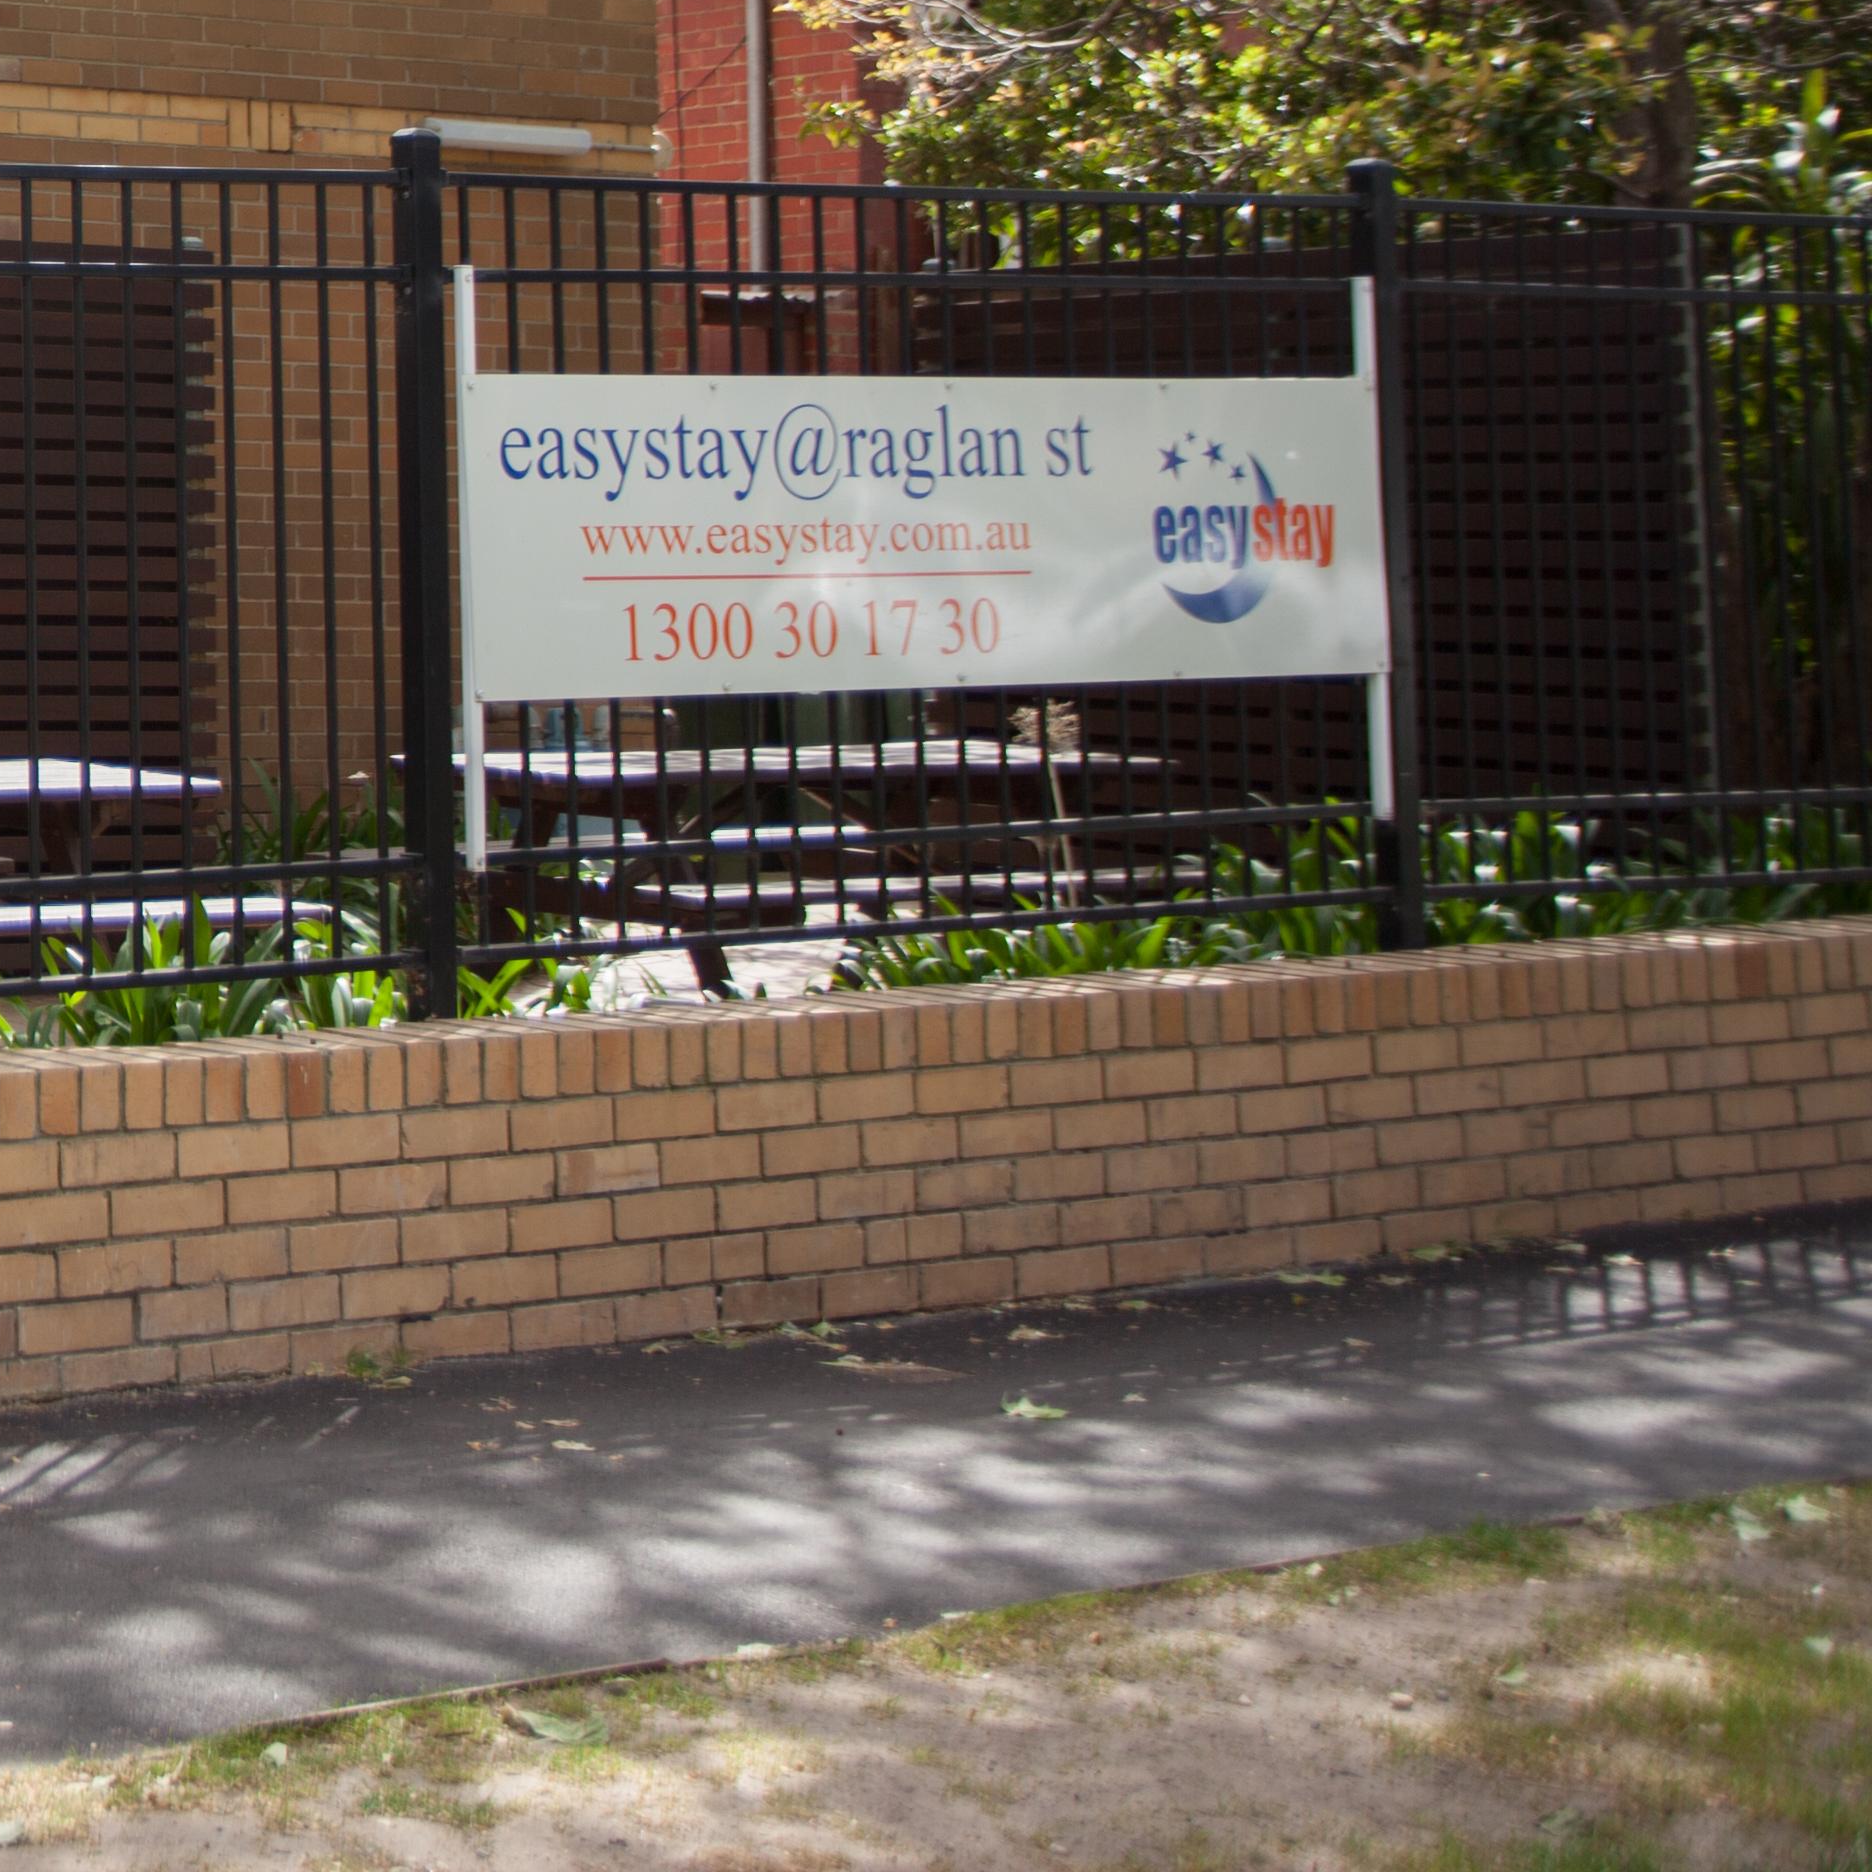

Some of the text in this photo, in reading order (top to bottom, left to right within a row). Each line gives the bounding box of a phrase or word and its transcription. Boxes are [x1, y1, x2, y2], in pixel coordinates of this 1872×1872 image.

[500, 403, 1094, 502] easystay@raglan st
[579, 517, 1032, 566] www.easystay.com.au
[622, 596, 1001, 661] 1300 30 17 30
